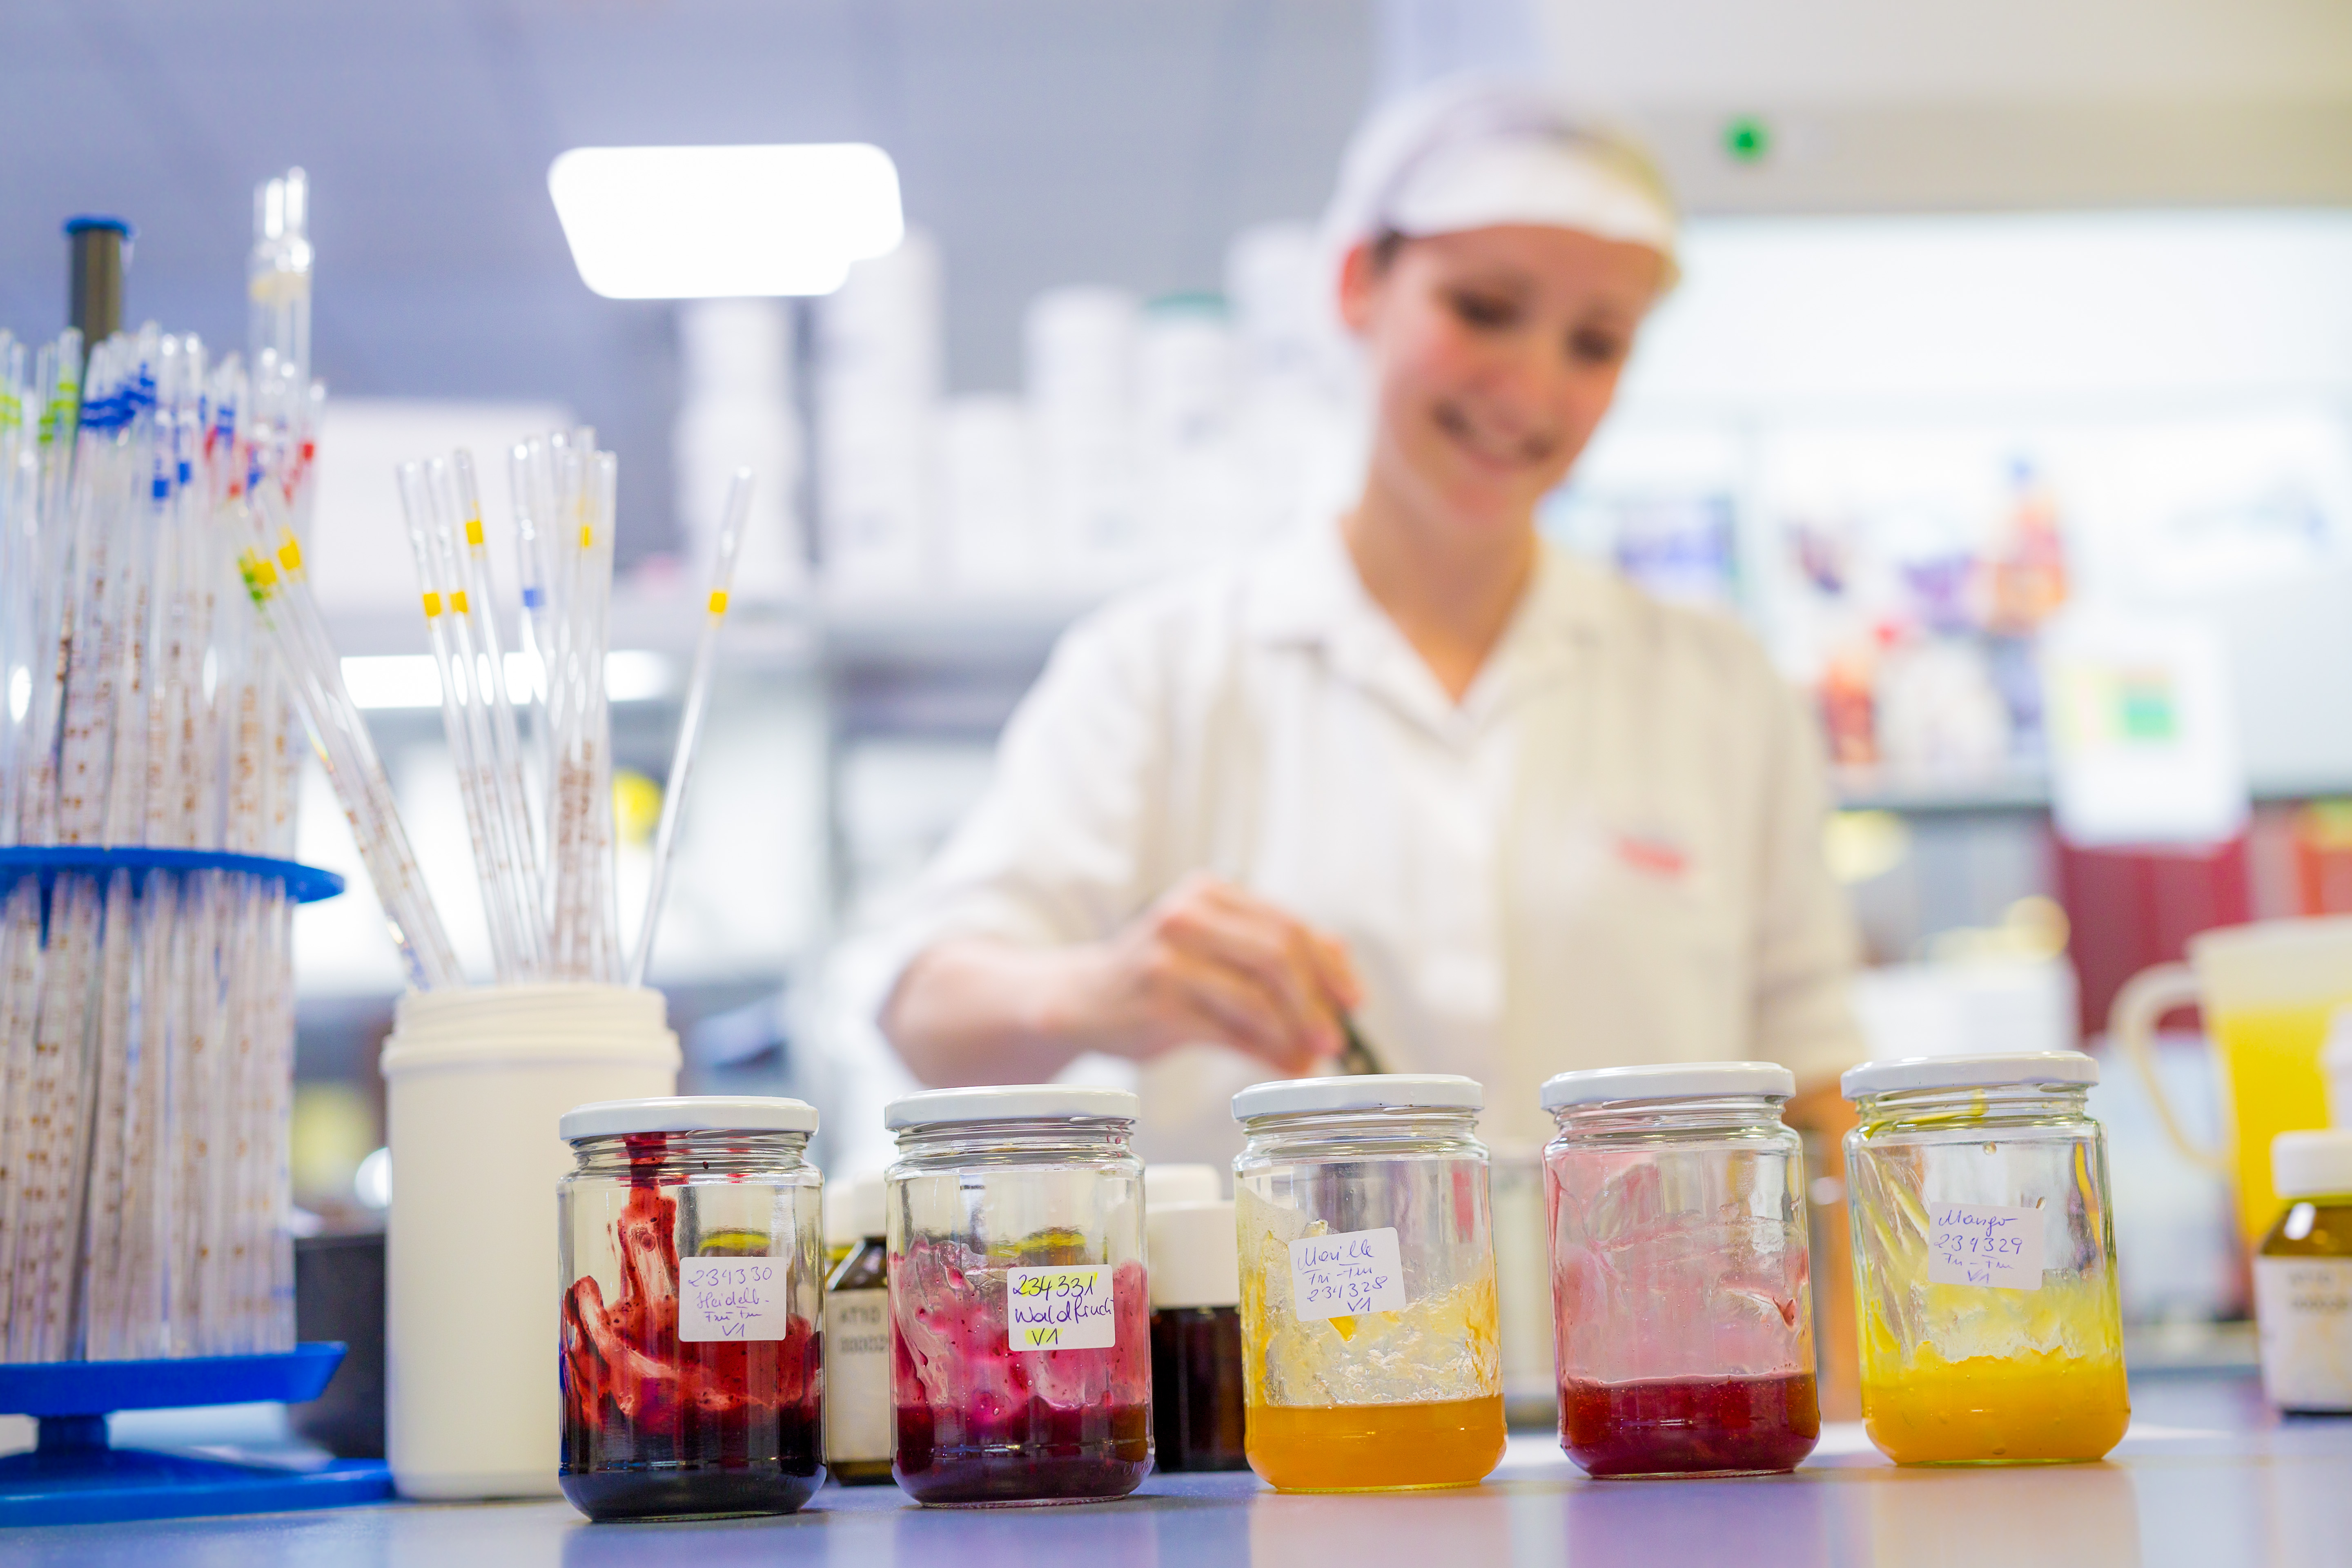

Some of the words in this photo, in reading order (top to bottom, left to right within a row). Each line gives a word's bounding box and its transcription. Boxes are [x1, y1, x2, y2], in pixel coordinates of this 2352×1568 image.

[1938, 1209, 2018, 1237] Mango
[1933, 1234, 2022, 1255] 234329
[688, 1266, 772, 1287] 234330
[1967, 1269, 1989, 1284] V1
[1013, 1274, 1093, 1301] 234331
[1307, 1276, 1388, 1302] 234328
[1347, 1297, 1371, 1312] V1
[722, 1323, 744, 1337] V1
[1031, 1327, 1058, 1346] V1
